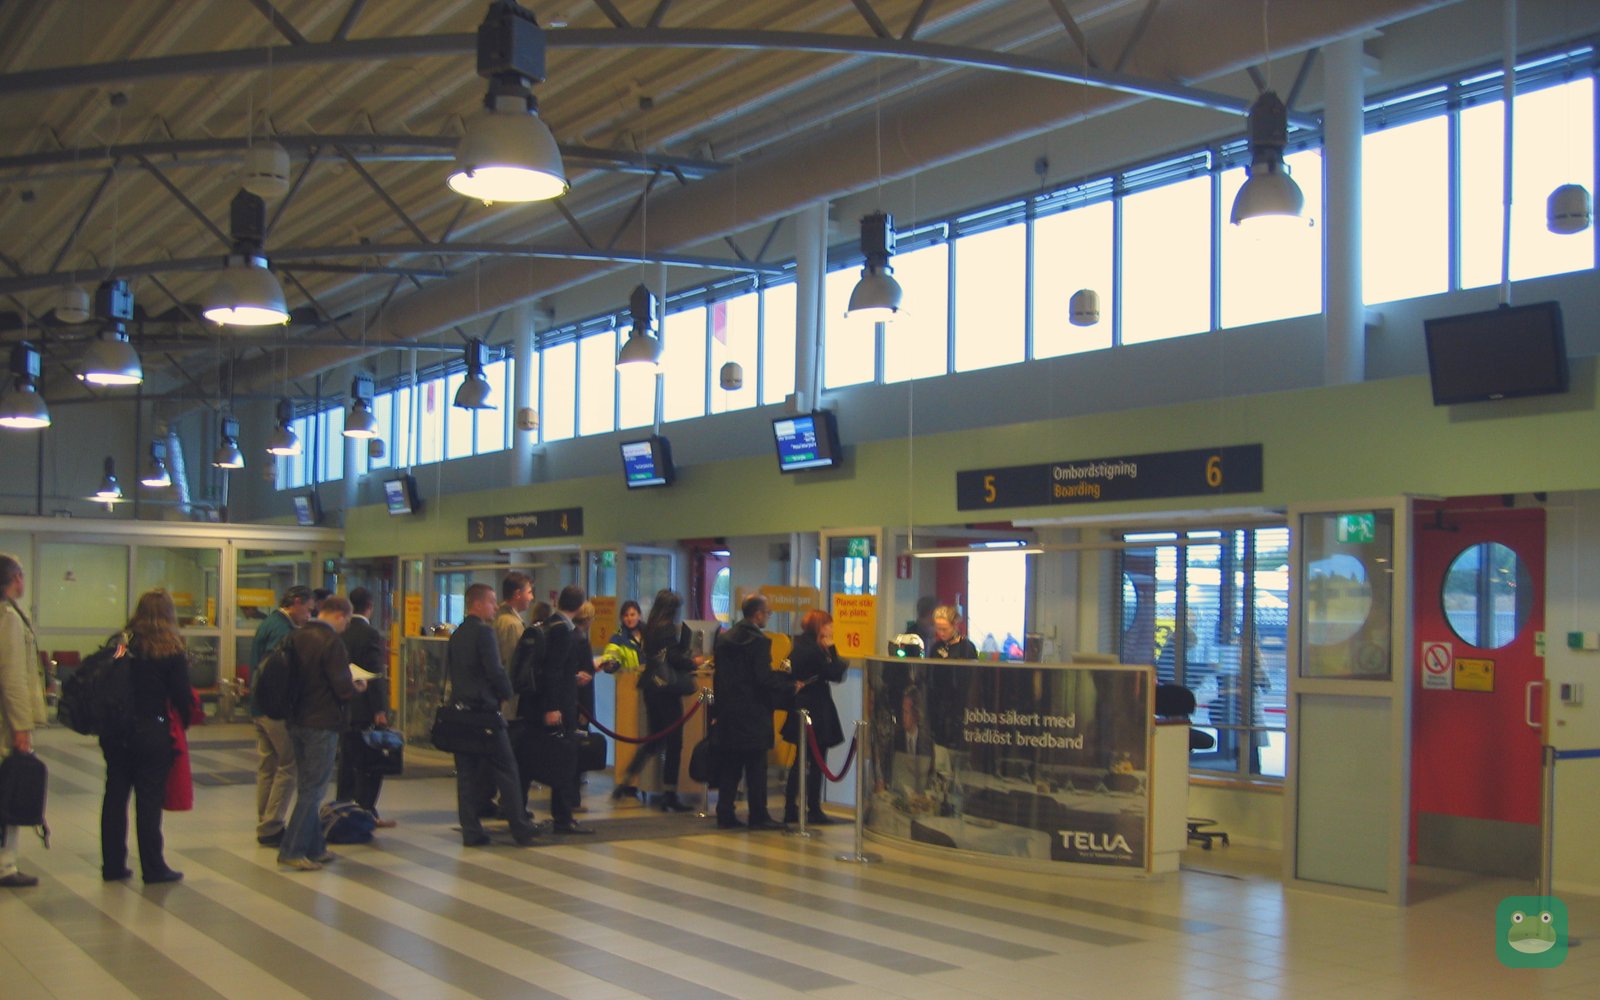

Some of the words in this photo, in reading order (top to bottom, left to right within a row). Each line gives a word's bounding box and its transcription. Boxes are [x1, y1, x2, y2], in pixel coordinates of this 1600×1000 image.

[1053, 460, 1137, 482] Ombordstigning
[1206, 455, 1223, 487] 6
[983, 476, 997, 503] 5
[1054, 481, 1100, 498] Boarding
[846, 632, 861, 648] 16
[964, 708, 997, 725] Jobba
[999, 709, 1040, 727] säkert
[1042, 712, 1075, 728] med
[963, 728, 1012, 746] trådlöst
[1016, 731, 1083, 749] bredband
[1058, 829, 1133, 853] TELIA
